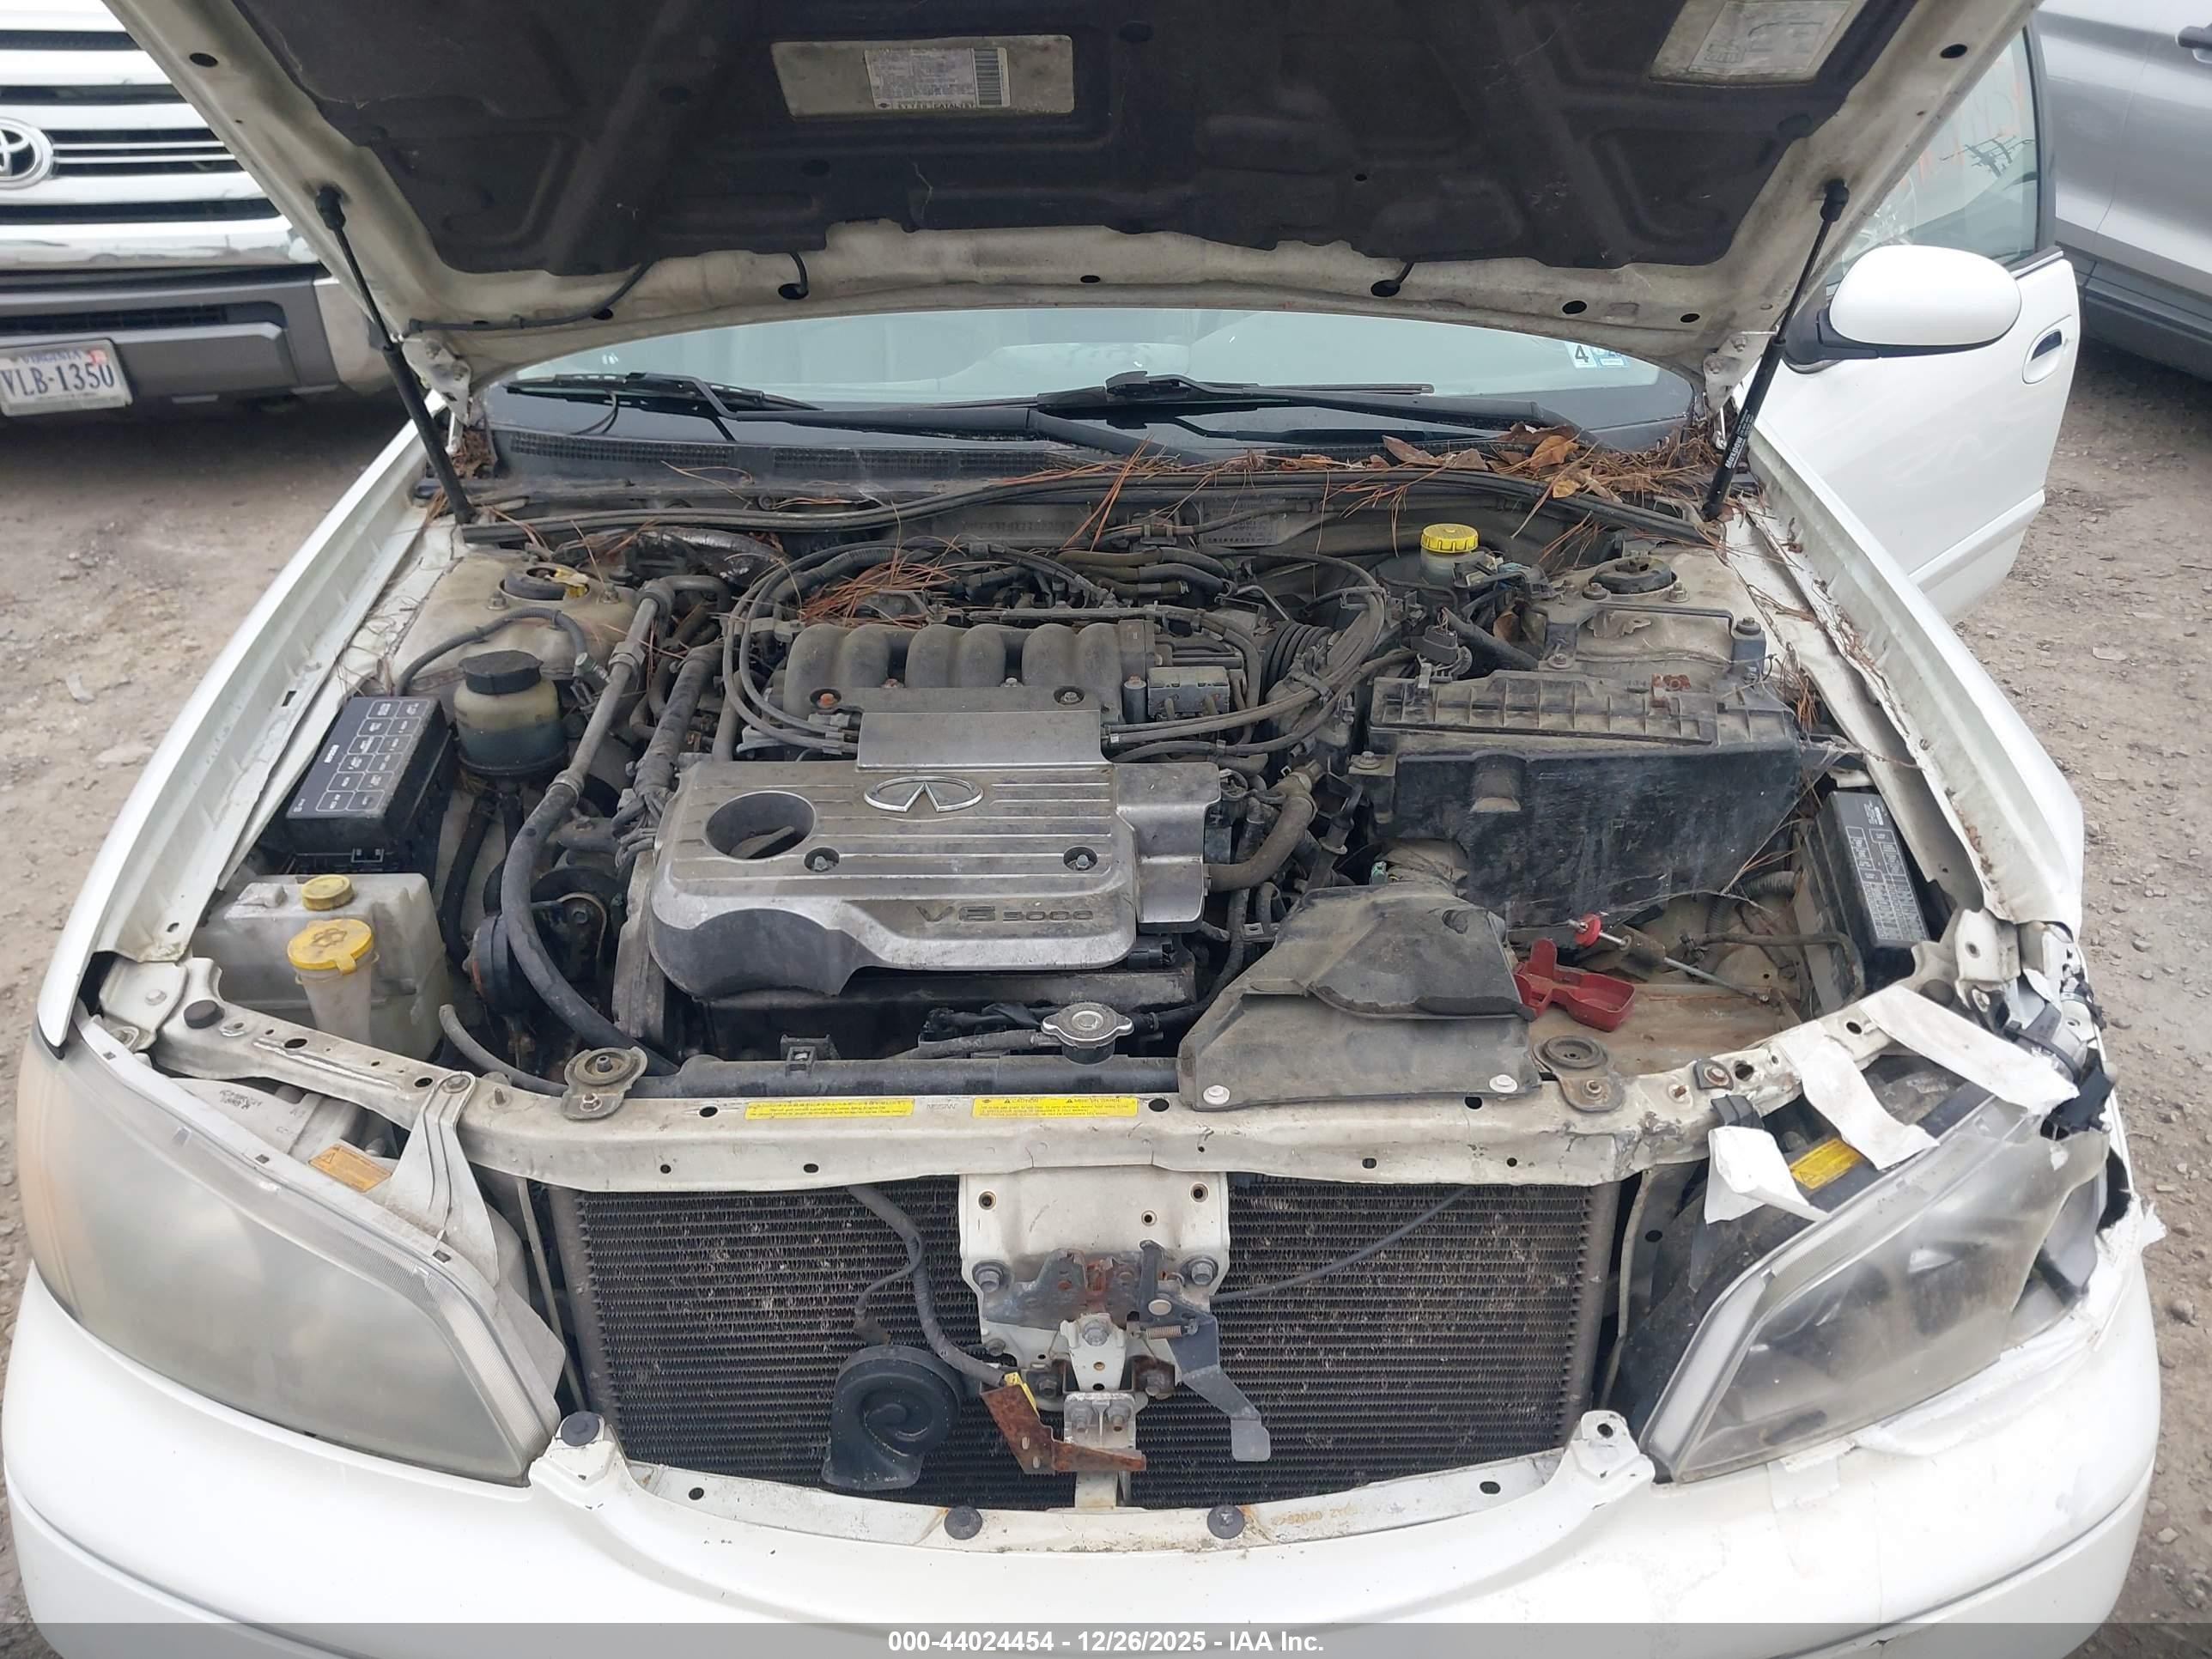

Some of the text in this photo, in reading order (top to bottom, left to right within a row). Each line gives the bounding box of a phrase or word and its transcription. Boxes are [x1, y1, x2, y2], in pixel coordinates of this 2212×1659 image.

[1574, 344, 1589, 363] 4
[915, 905, 1094, 923] V6 3000
